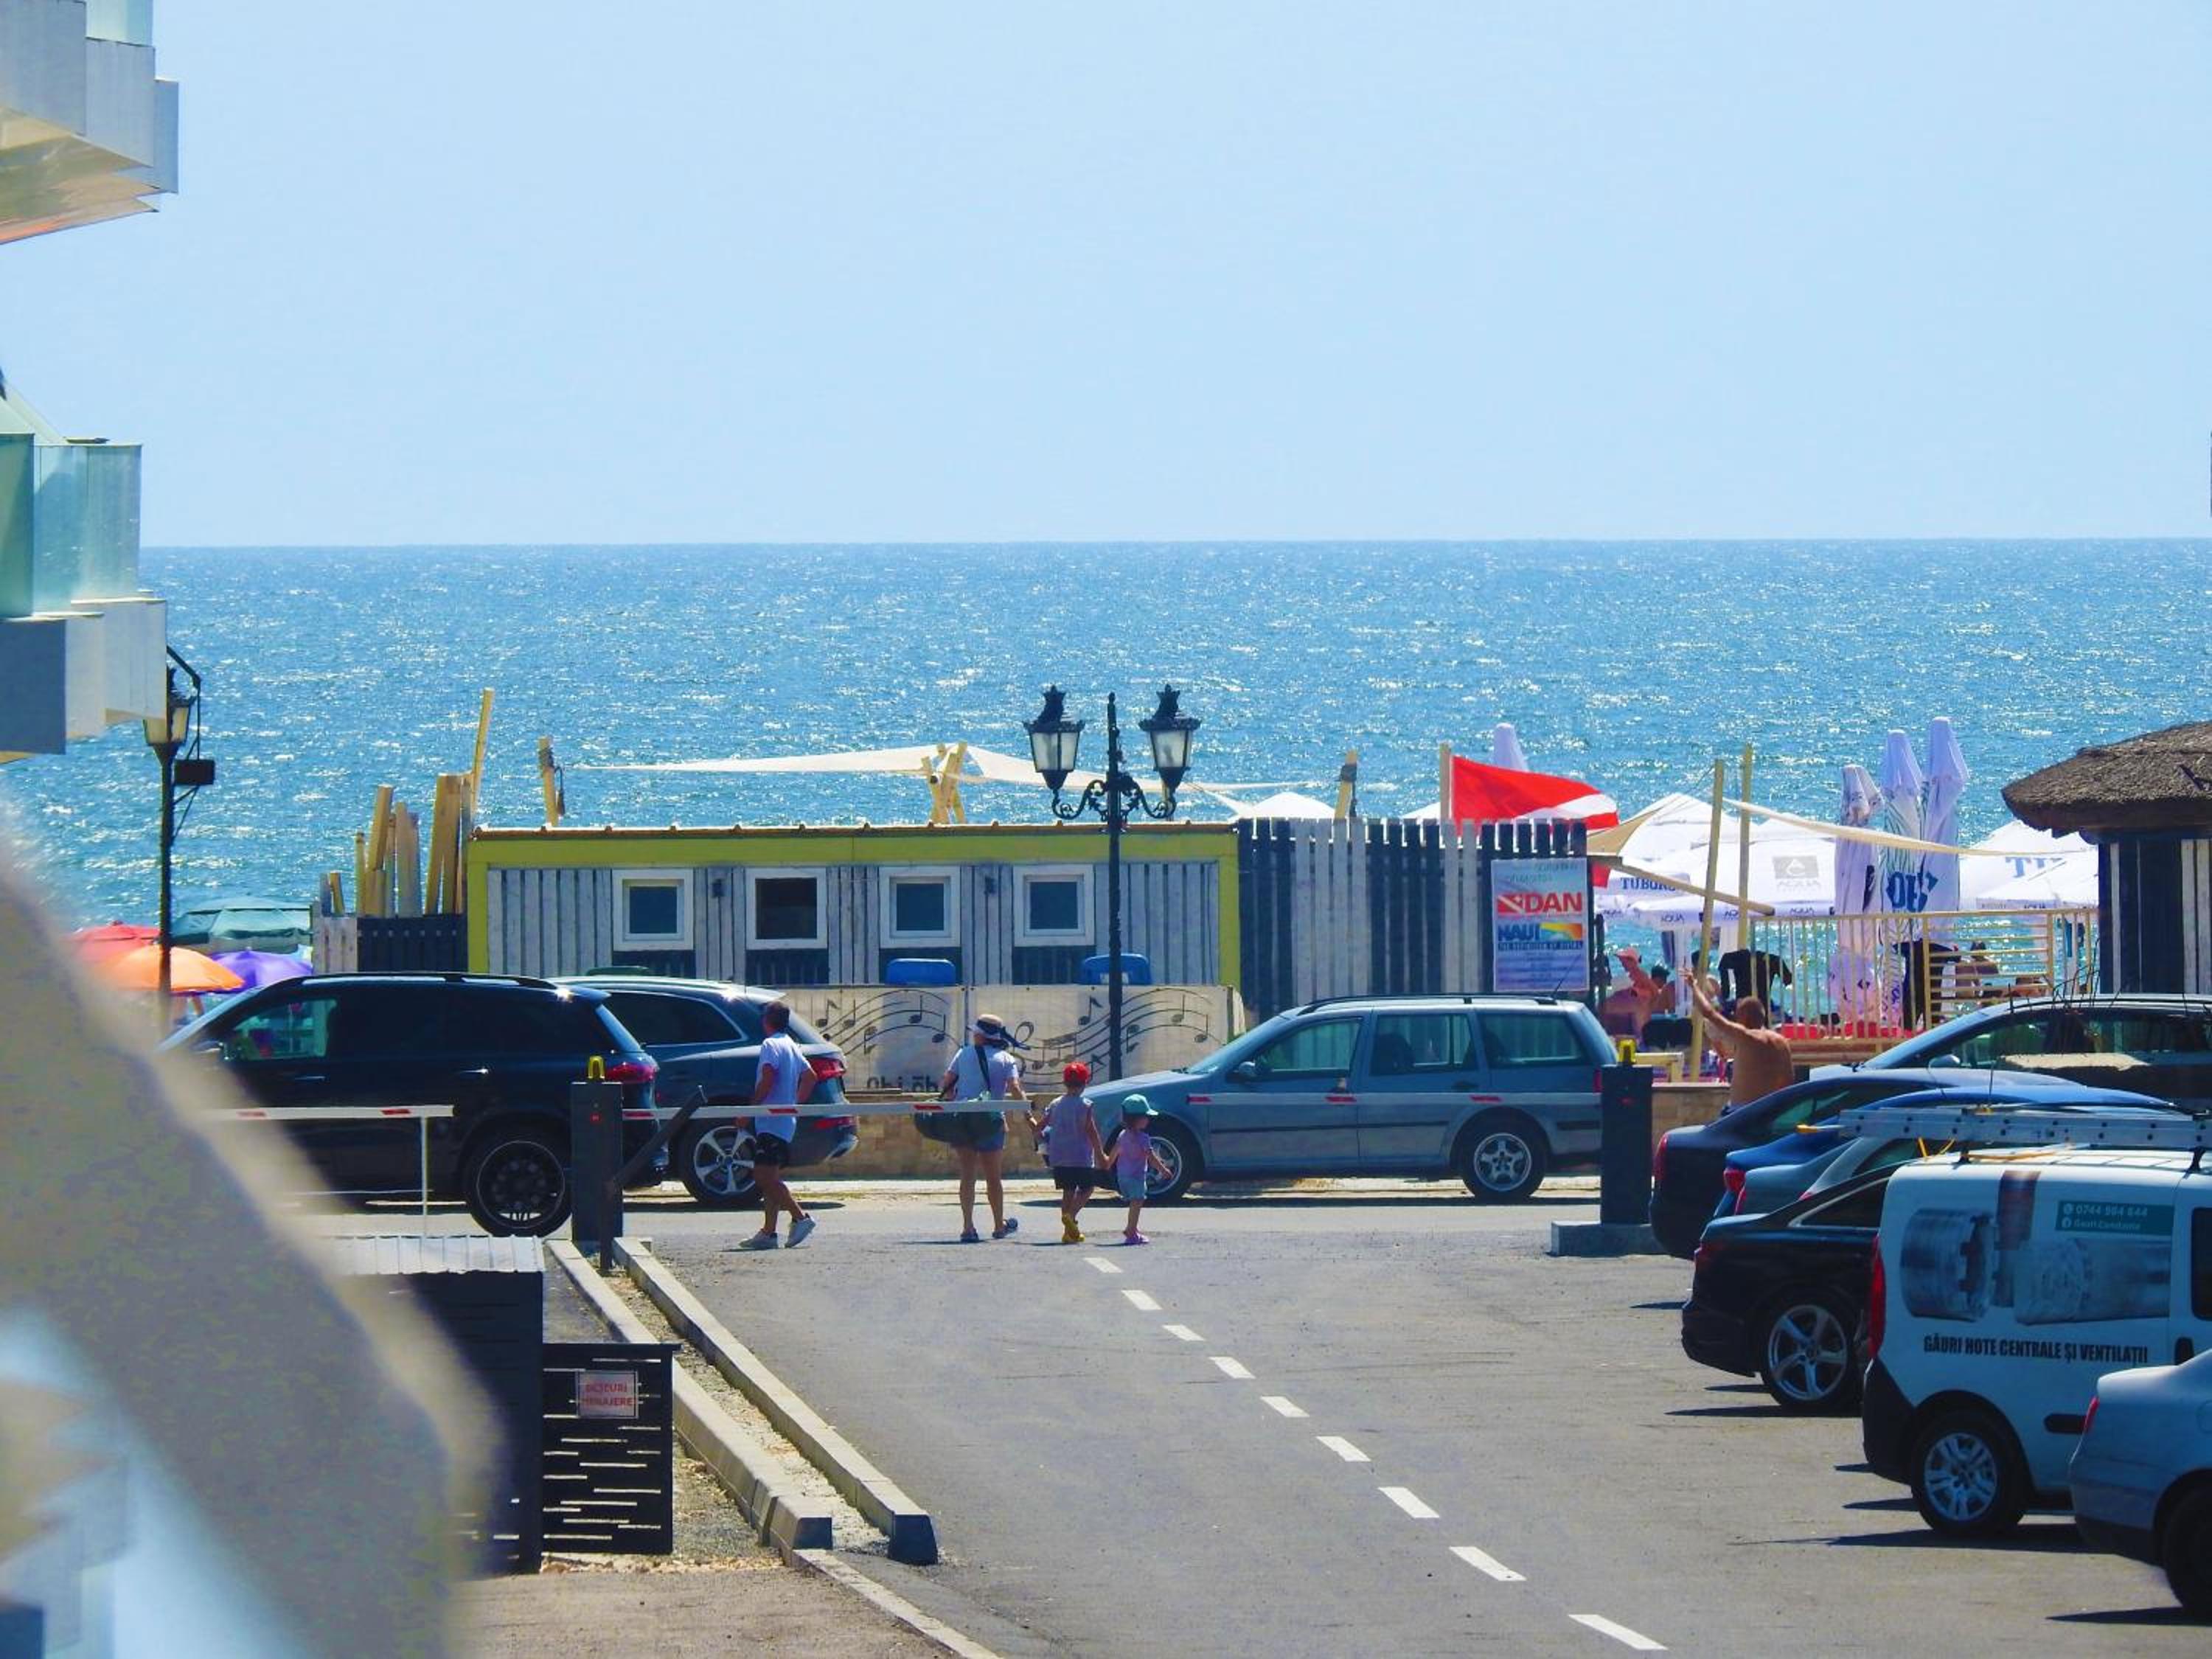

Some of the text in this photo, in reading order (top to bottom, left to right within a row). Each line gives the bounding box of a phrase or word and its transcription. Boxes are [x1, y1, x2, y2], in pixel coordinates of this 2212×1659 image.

[1525, 892, 1582, 913] DAN
[1498, 923, 1540, 942] NAUI
[1965, 1338, 1997, 1355] HOTE
[2000, 1340, 2062, 1359] CENTRALE
